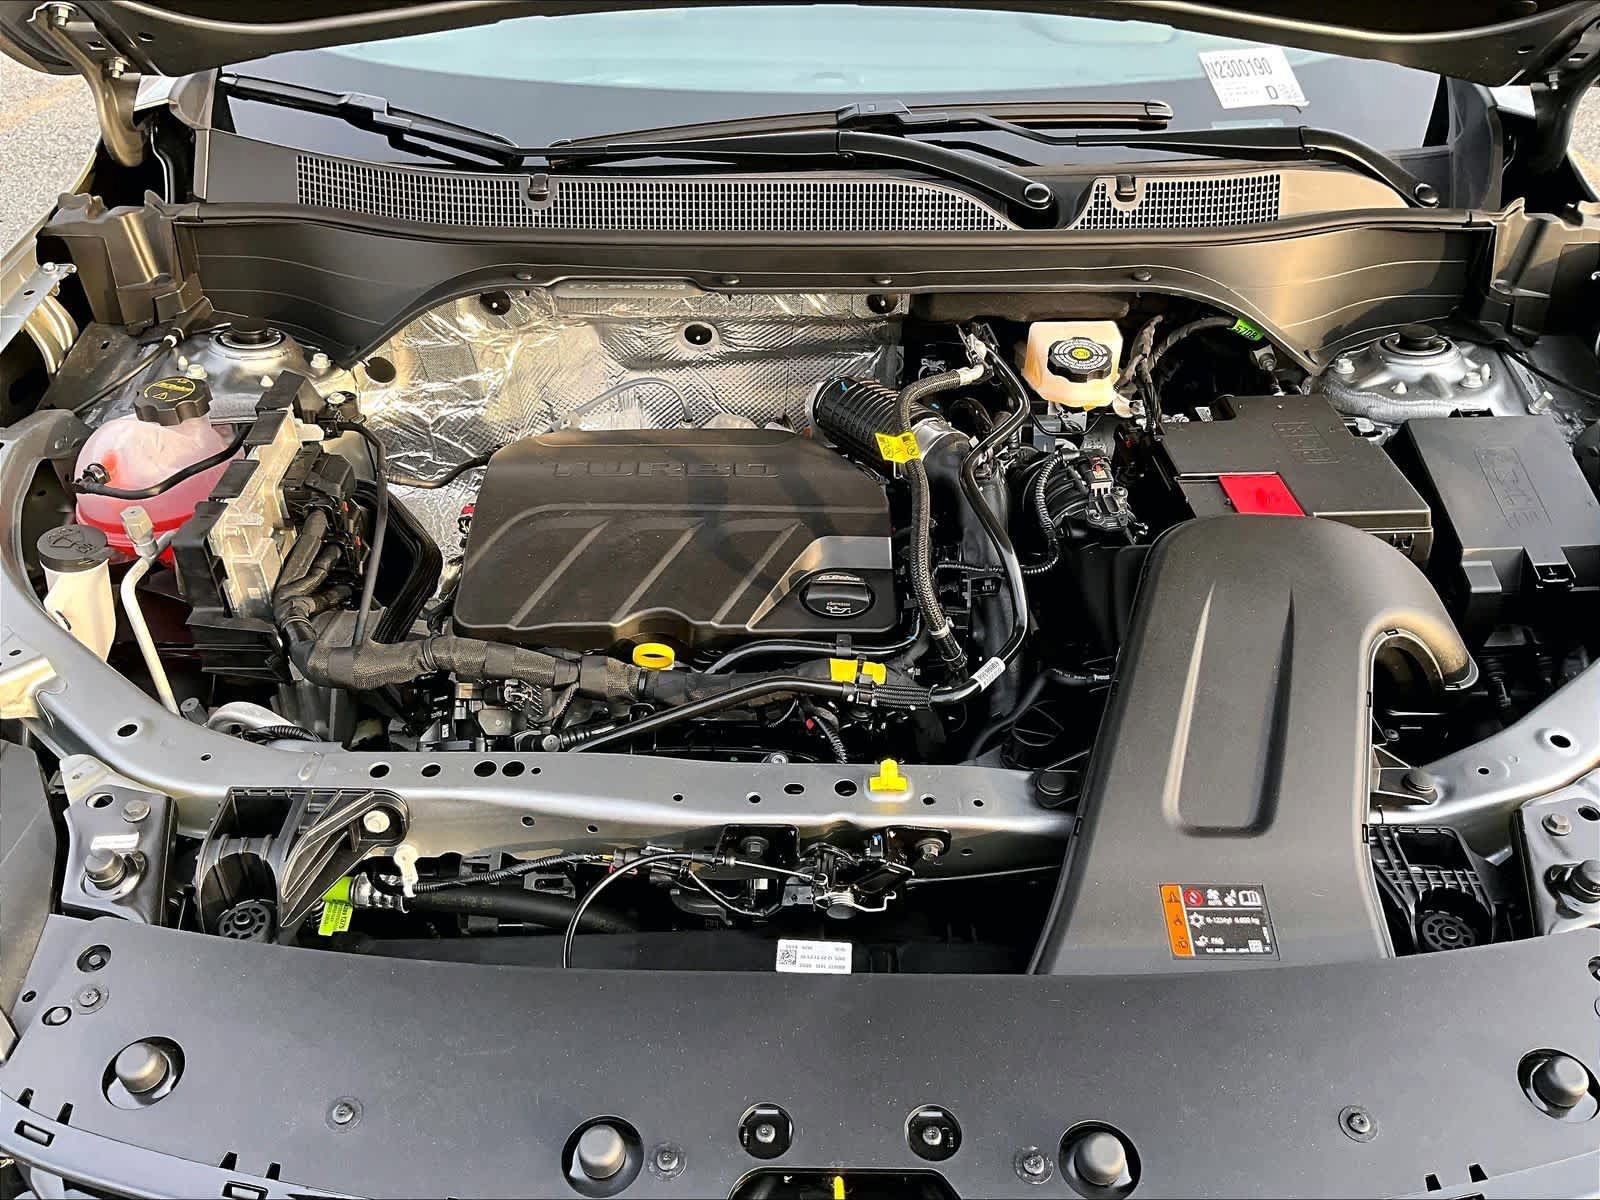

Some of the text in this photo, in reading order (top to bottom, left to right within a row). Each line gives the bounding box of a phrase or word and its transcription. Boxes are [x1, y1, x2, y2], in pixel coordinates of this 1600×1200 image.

[1205, 57, 1272, 79] N2300190
[1264, 85, 1280, 100] D
[552, 461, 780, 478] TURBO
